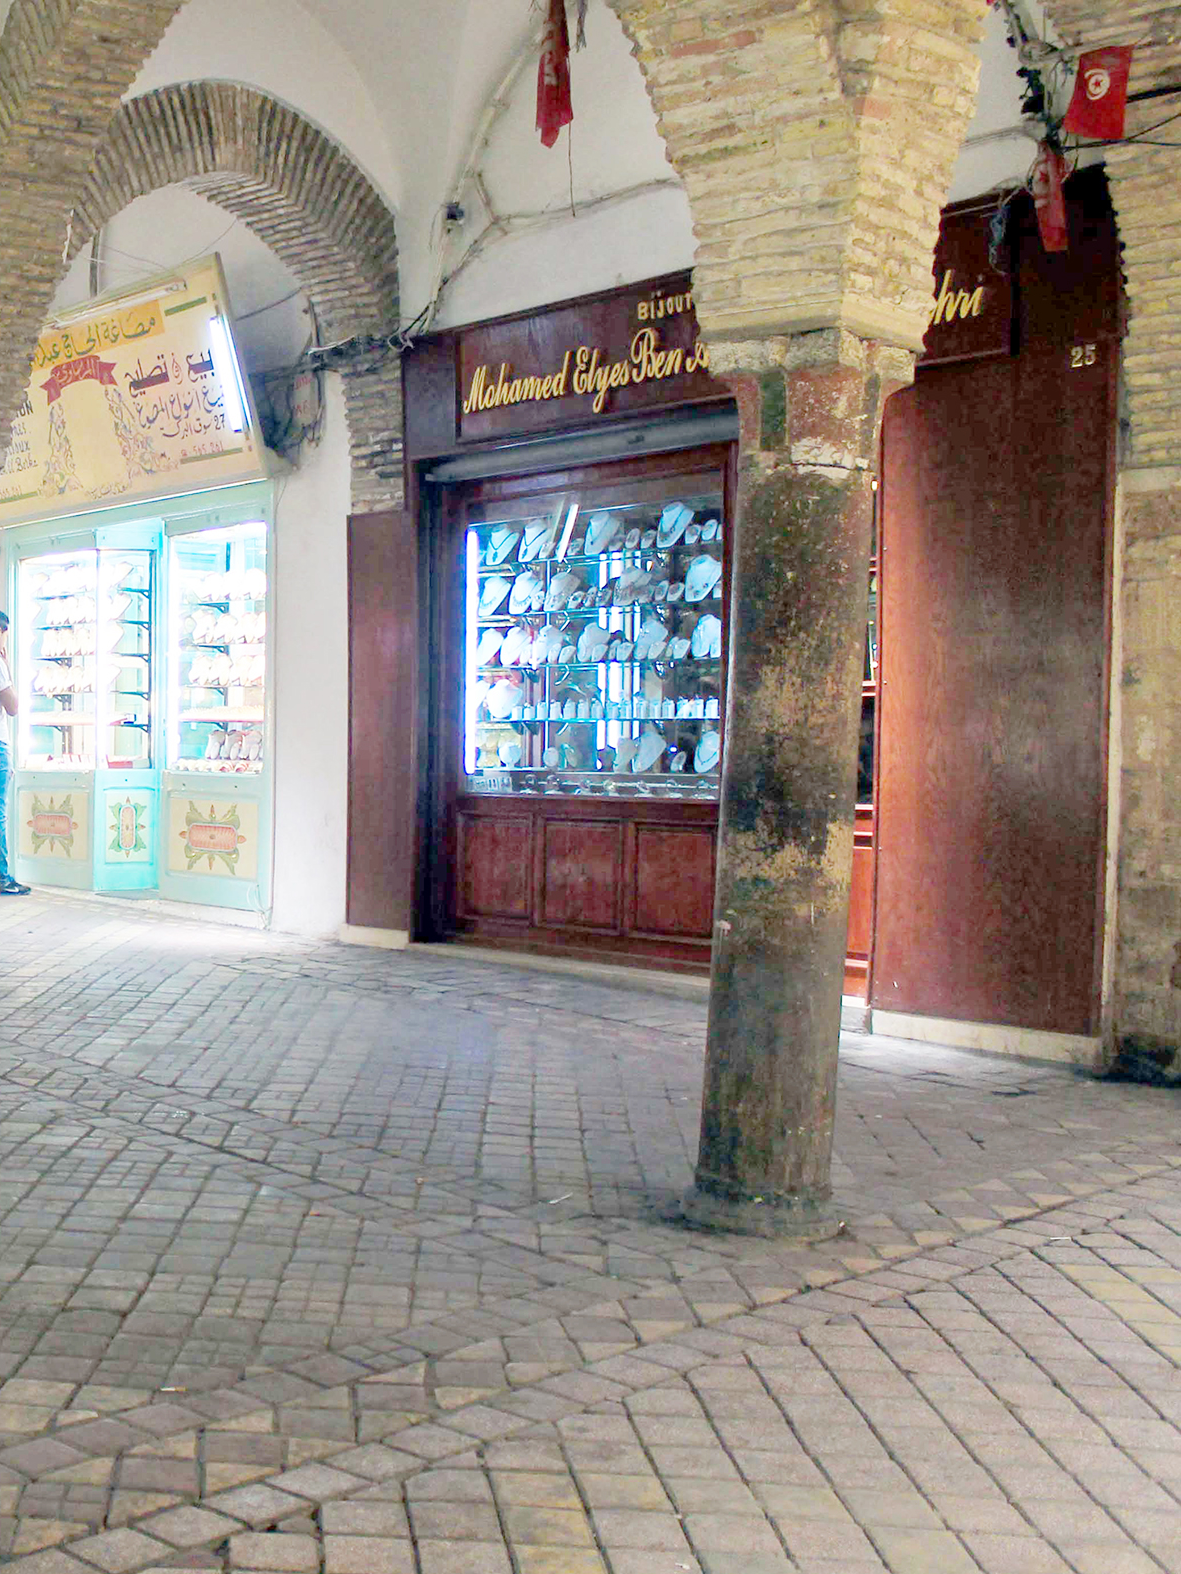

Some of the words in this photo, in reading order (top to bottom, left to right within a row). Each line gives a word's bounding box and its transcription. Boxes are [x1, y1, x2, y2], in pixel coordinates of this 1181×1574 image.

[637, 290, 692, 319] BIJOUT
[930, 269, 985, 325] hri
[185, 348, 214, 383] بيع
[463, 350, 572, 414] Mohamed
[573, 345, 631, 413] Elyes
[630, 327, 684, 383] Ben
[1069, 344, 1097, 369] 25
